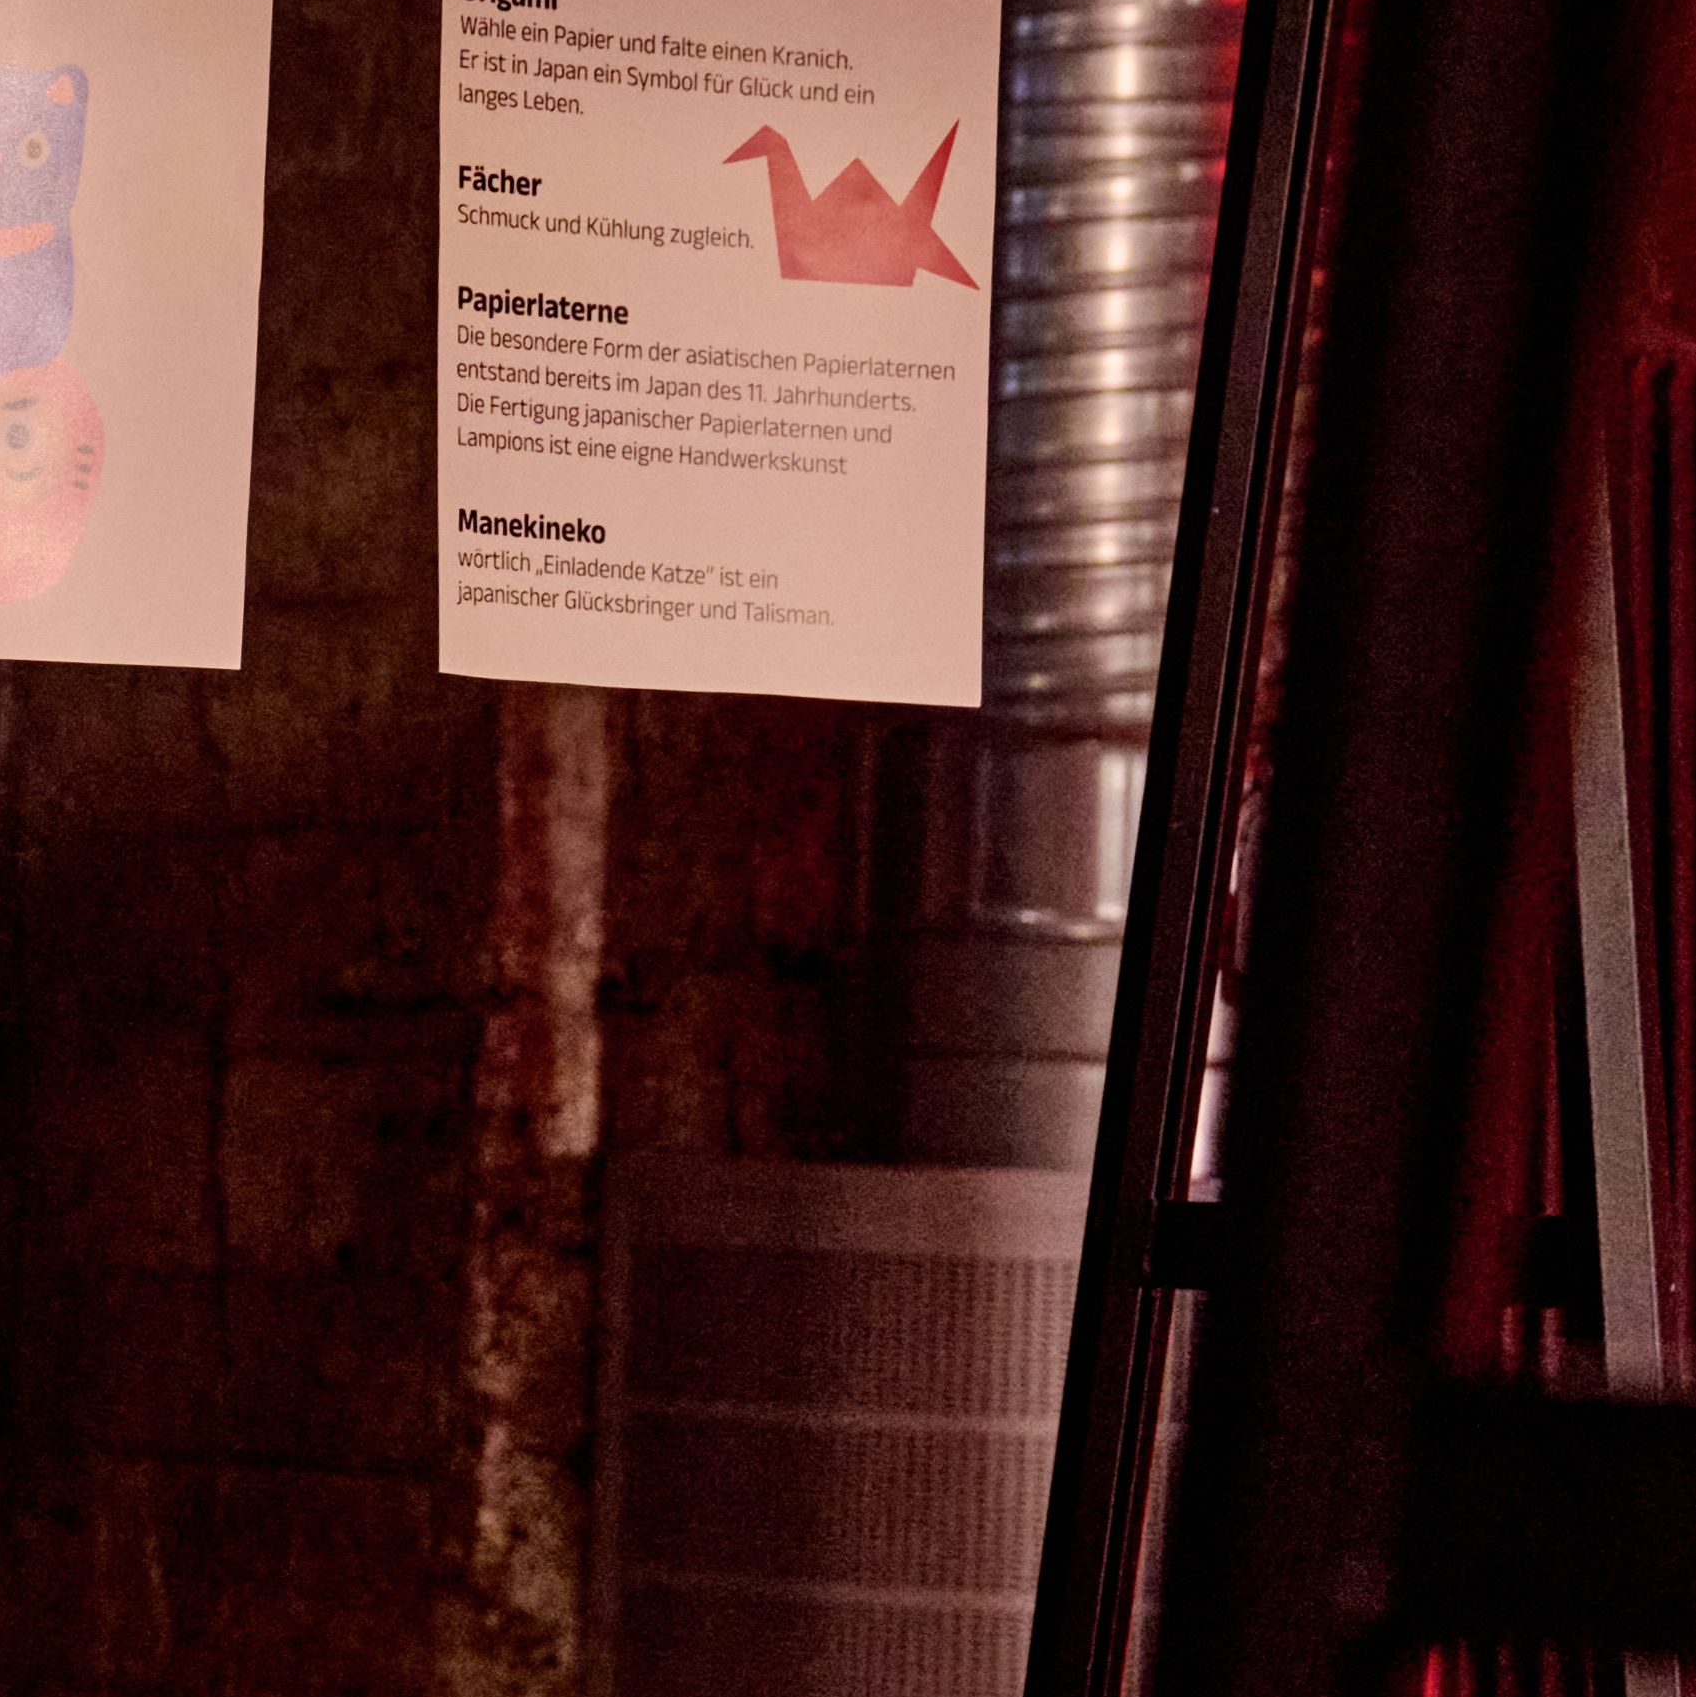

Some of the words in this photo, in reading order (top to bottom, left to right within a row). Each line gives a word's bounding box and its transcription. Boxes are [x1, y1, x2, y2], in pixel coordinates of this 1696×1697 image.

[460, 14, 517, 41] Wähle
[521, 21, 549, 44] ein
[554, 25, 614, 53] Papier
[619, 33, 656, 56] und
[661, 35, 707, 59] falte
[712, 41, 766, 64] einen
[772, 46, 853, 71] Kranich.
[458, 48, 479, 69] Er
[483, 51, 506, 73] ist
[511, 54, 528, 75] in
[533, 57, 588, 83] Japan
[593, 62, 622, 85] ein
[627, 66, 698, 94] Symbol
[703, 72, 734, 95] für
[739, 75, 793, 99] Glück
[799, 81, 838, 103] und
[844, 84, 875, 105] ein
[458, 83, 518, 111] langes
[523, 90, 584, 115] Leben.
[458, 164, 543, 197] Fächer
[457, 203, 540, 231] Schmuck
[545, 214, 581, 235] und
[586, 216, 664, 247] Kühlung
[669, 225, 754, 250] zugleich.
[457, 285, 629, 325] Papierlaterne
[457, 324, 485, 346] Die
[490, 327, 588, 356] besondere
[593, 337, 642, 360] Form
[648, 342, 680, 364] der
[685, 344, 797, 371] asiatischen
[803, 352, 955, 380] Papierlaternen
[456, 359, 540, 385] entstand
[545, 366, 611, 391] bereits
[616, 372, 639, 393] im
[645, 375, 701, 400] Japan
[707, 380, 741, 402] des
[746, 383, 766, 403] 11.
[773, 384, 915, 413] Jahrhunderts.
[457, 392, 485, 414] Die
[489, 395, 580, 427] Fertigung
[583, 403, 694, 432] japanischer
[699, 412, 847, 440] Papierlaternen
[853, 423, 891, 443] und
[457, 427, 544, 454] Lampions
[549, 433, 572, 455] ist
[576, 436, 616, 459] eine
[621, 440, 673, 466] eigne
[679, 444, 847, 475] Handwerkskunst
[457, 508, 606, 545] Manekineko
[457, 548, 531, 573] wörtlich
[719, 566, 743, 588] ist
[748, 570, 778, 589] ein
[457, 581, 559, 608] japanischer
[564, 589, 694, 621] Glücksbringer
[699, 599, 736, 620] und
[743, 601, 835, 626] Talisman.
